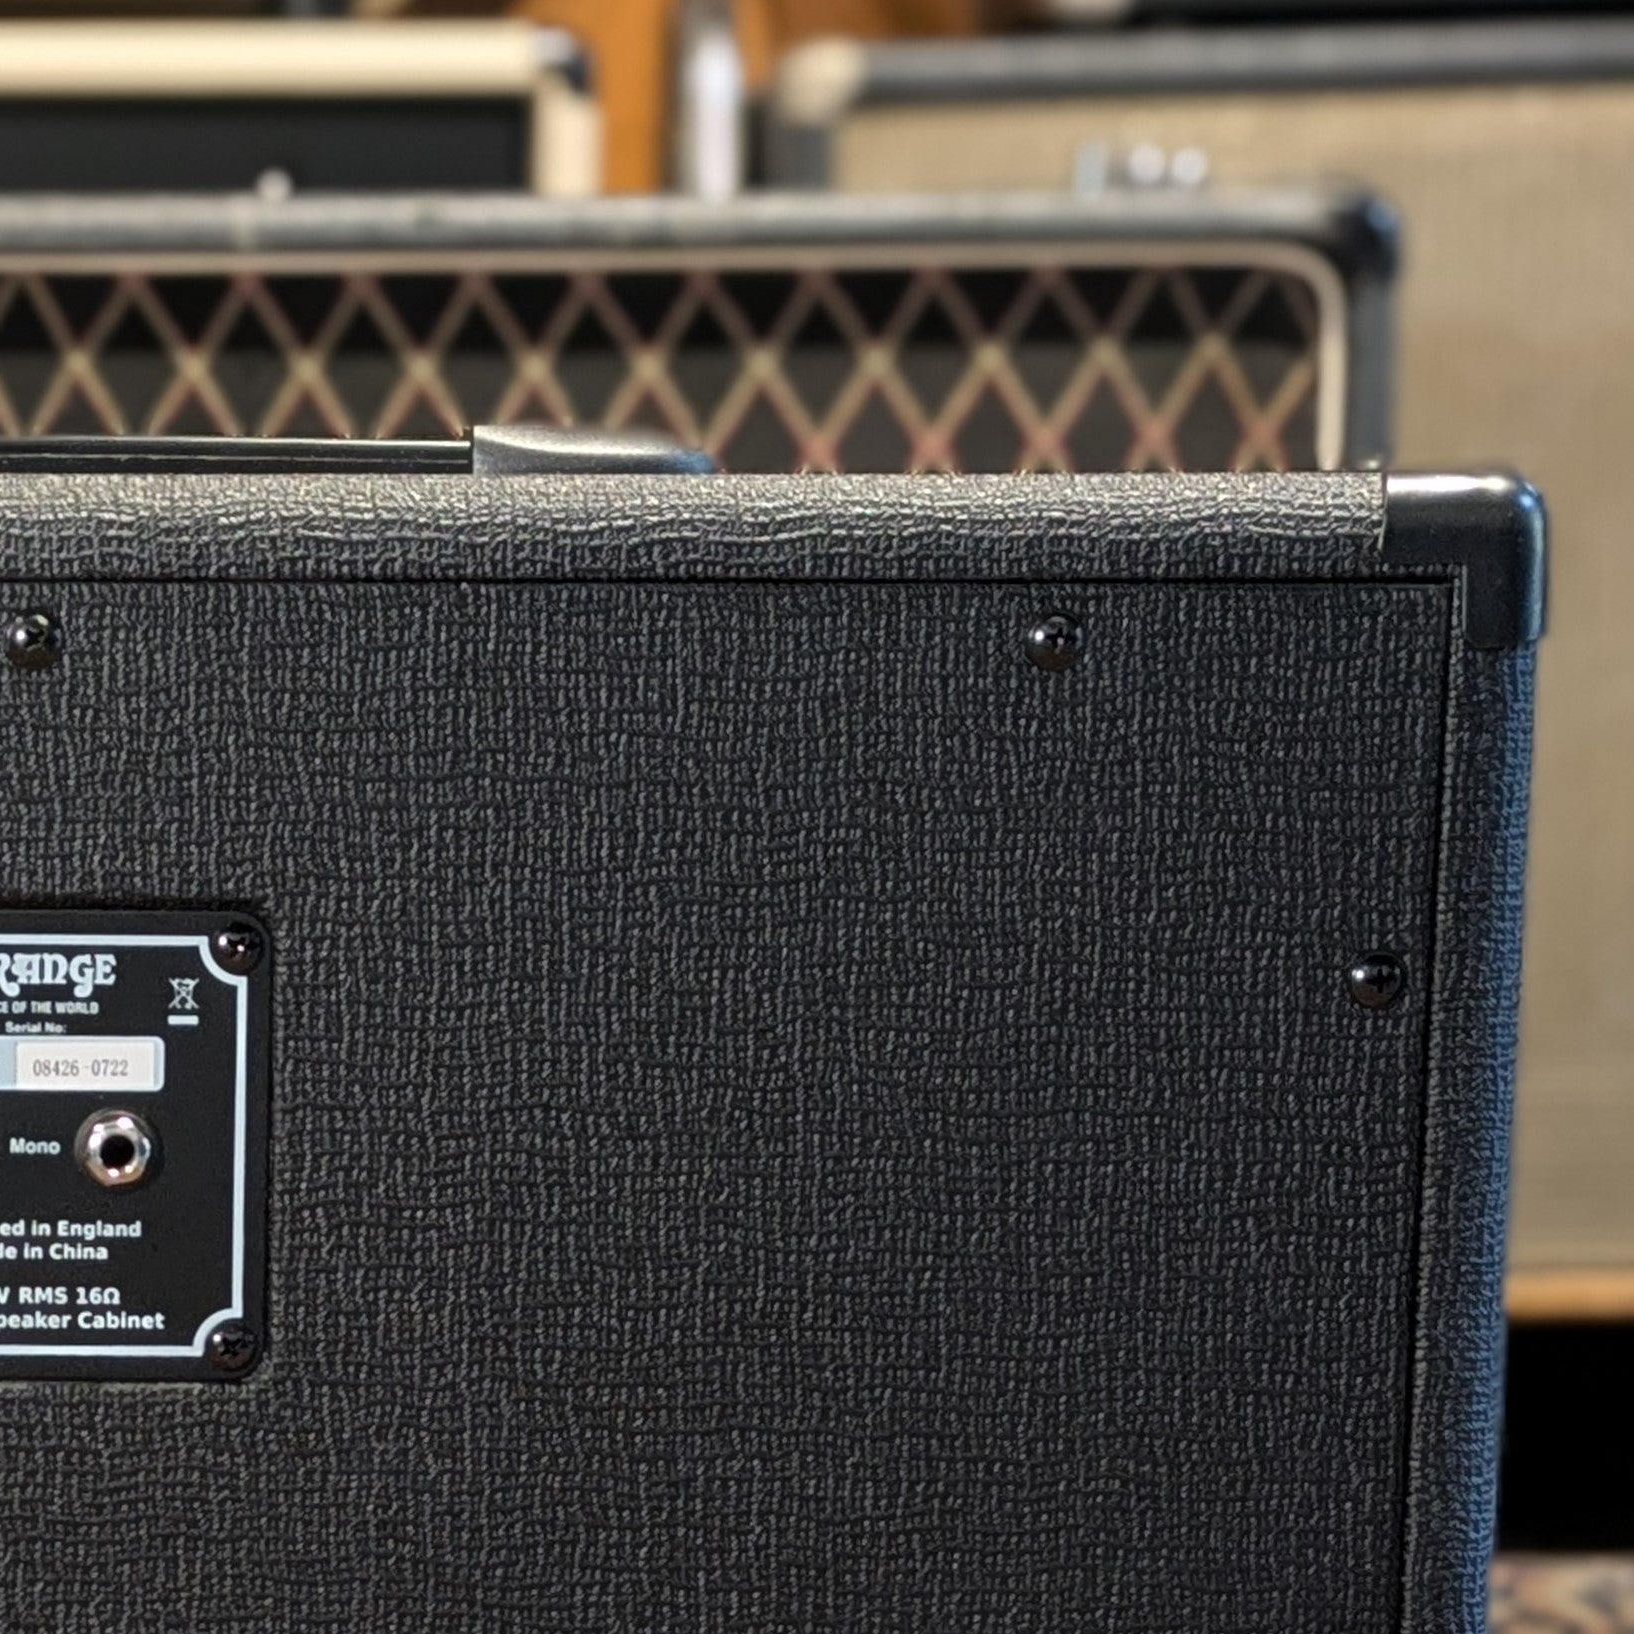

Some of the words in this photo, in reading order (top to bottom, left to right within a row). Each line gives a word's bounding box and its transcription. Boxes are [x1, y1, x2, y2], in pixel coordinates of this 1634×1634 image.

[12, 1001, 27, 1014] OF
[30, 1001, 53, 1015] THE
[55, 1001, 100, 1015] WORLD
[4, 1021, 42, 1033] Serial
[44, 1022, 67, 1034] No:
[9, 1137, 61, 1155] Mono
[31, 1219, 52, 1237] in
[57, 1220, 142, 1240] England
[24, 1242, 44, 1260] in
[49, 1243, 109, 1261] China
[18, 1286, 69, 1305] RMS
[76, 1287, 121, 1305] 16Ω
[78, 1311, 165, 1330] Cabinet
